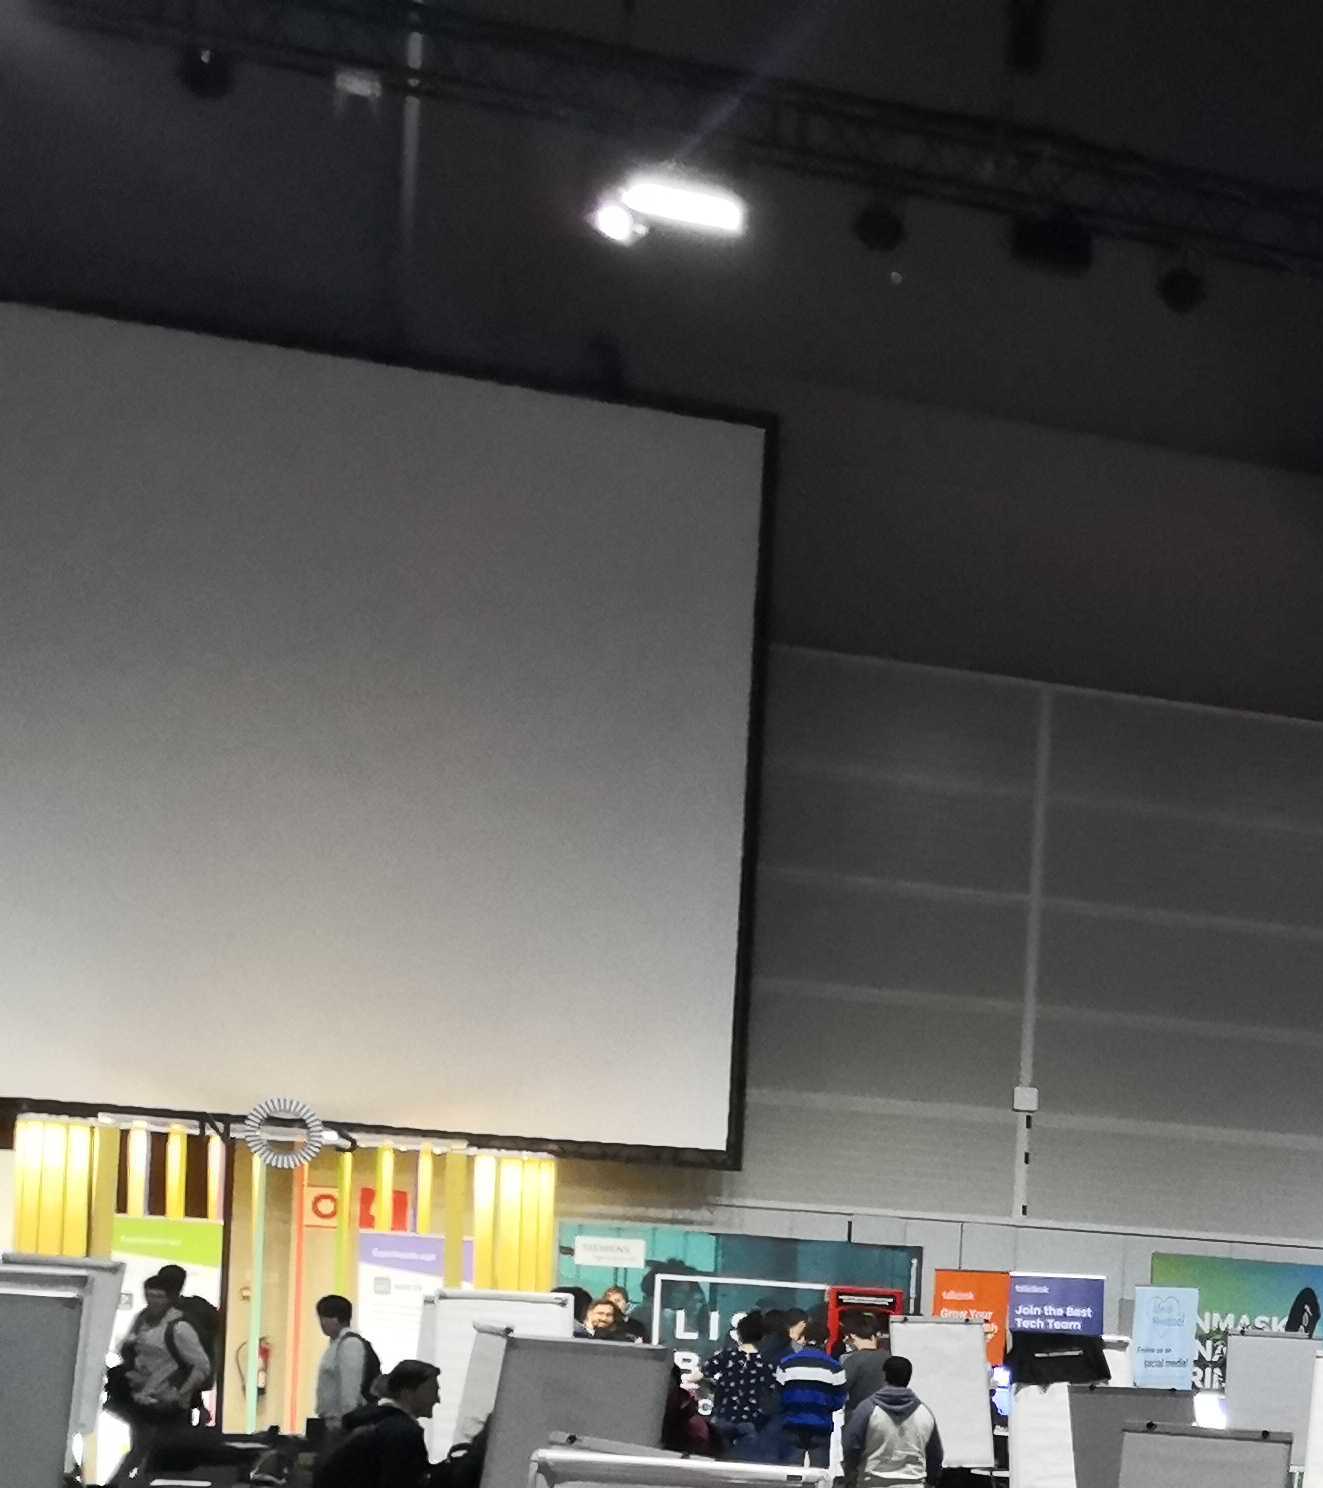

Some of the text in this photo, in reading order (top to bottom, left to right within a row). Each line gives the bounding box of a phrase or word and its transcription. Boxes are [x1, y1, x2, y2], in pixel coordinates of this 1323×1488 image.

[1015, 1305, 1093, 1318] Join the Best
[1015, 1318, 1081, 1331] Tech Team
[1196, 1312, 1287, 1333] NMASK
